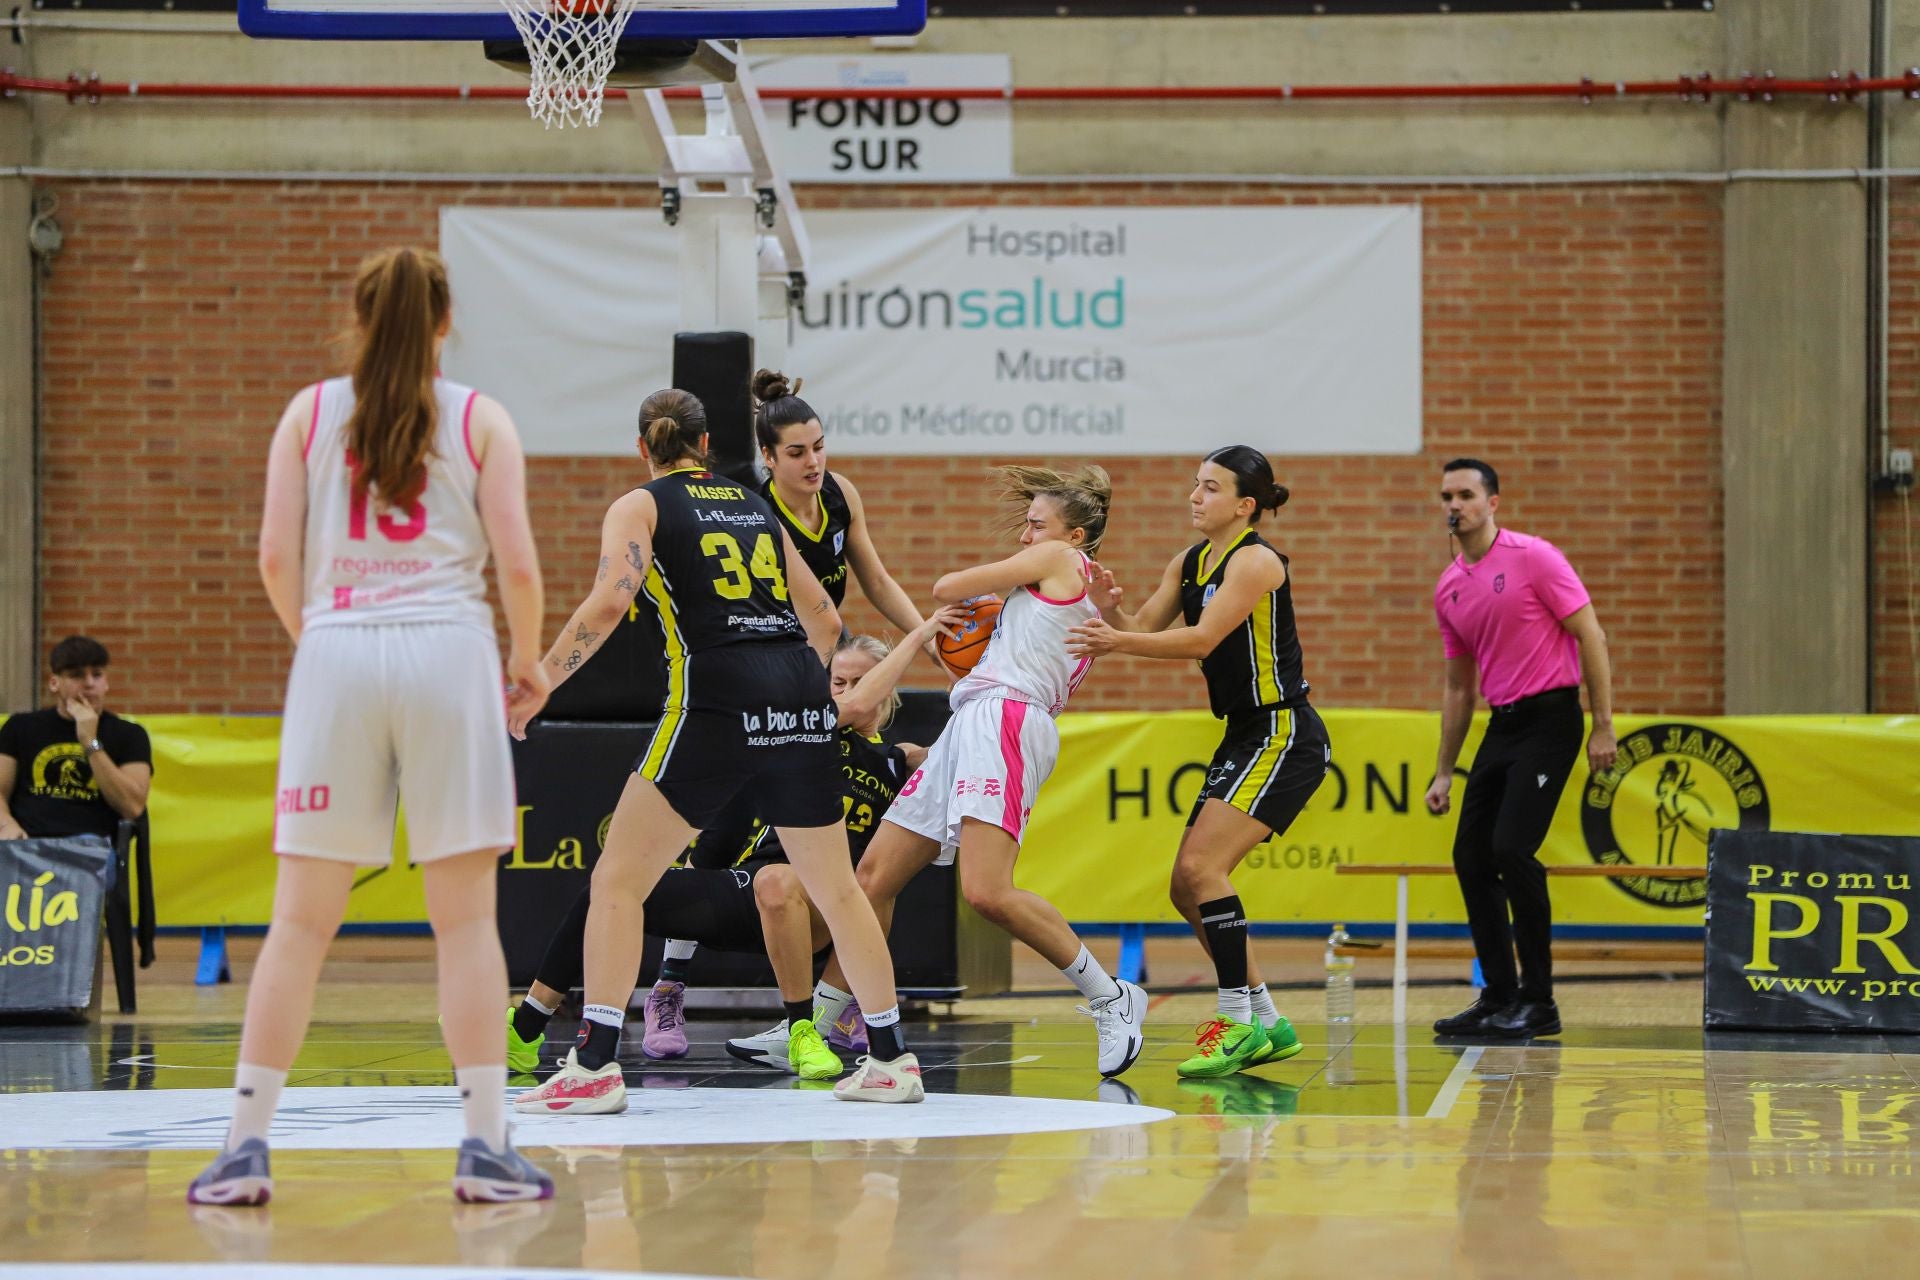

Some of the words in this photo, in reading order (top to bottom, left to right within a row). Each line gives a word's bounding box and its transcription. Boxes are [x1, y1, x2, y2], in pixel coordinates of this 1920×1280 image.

[789, 97, 961, 128] FONDO
[832, 140, 921, 171] SUR
[967, 225, 1126, 262] Hospital
[997, 351, 1126, 382] Murcia
[901, 402, 1013, 437] Médico
[1023, 402, 1125, 437] Oficial
[685, 484, 746, 500] MASSEY
[695, 509, 712, 522] La
[712, 510, 766, 525] Hacienda
[700, 532, 788, 602] 34
[742, 712, 761, 733] la
[766, 706, 797, 732] boca
[802, 708, 820, 730] te
[747, 736, 769, 746] MÁS
[1588, 734, 1654, 809] CLUB
[1662, 727, 1762, 809] JAIRIS
[504, 804, 586, 870] La
[1747, 864, 1912, 890] Promu
[5, 870, 80, 933] lía
[1743, 892, 1920, 976] PR
[1746, 975, 1920, 1002] www.pro
